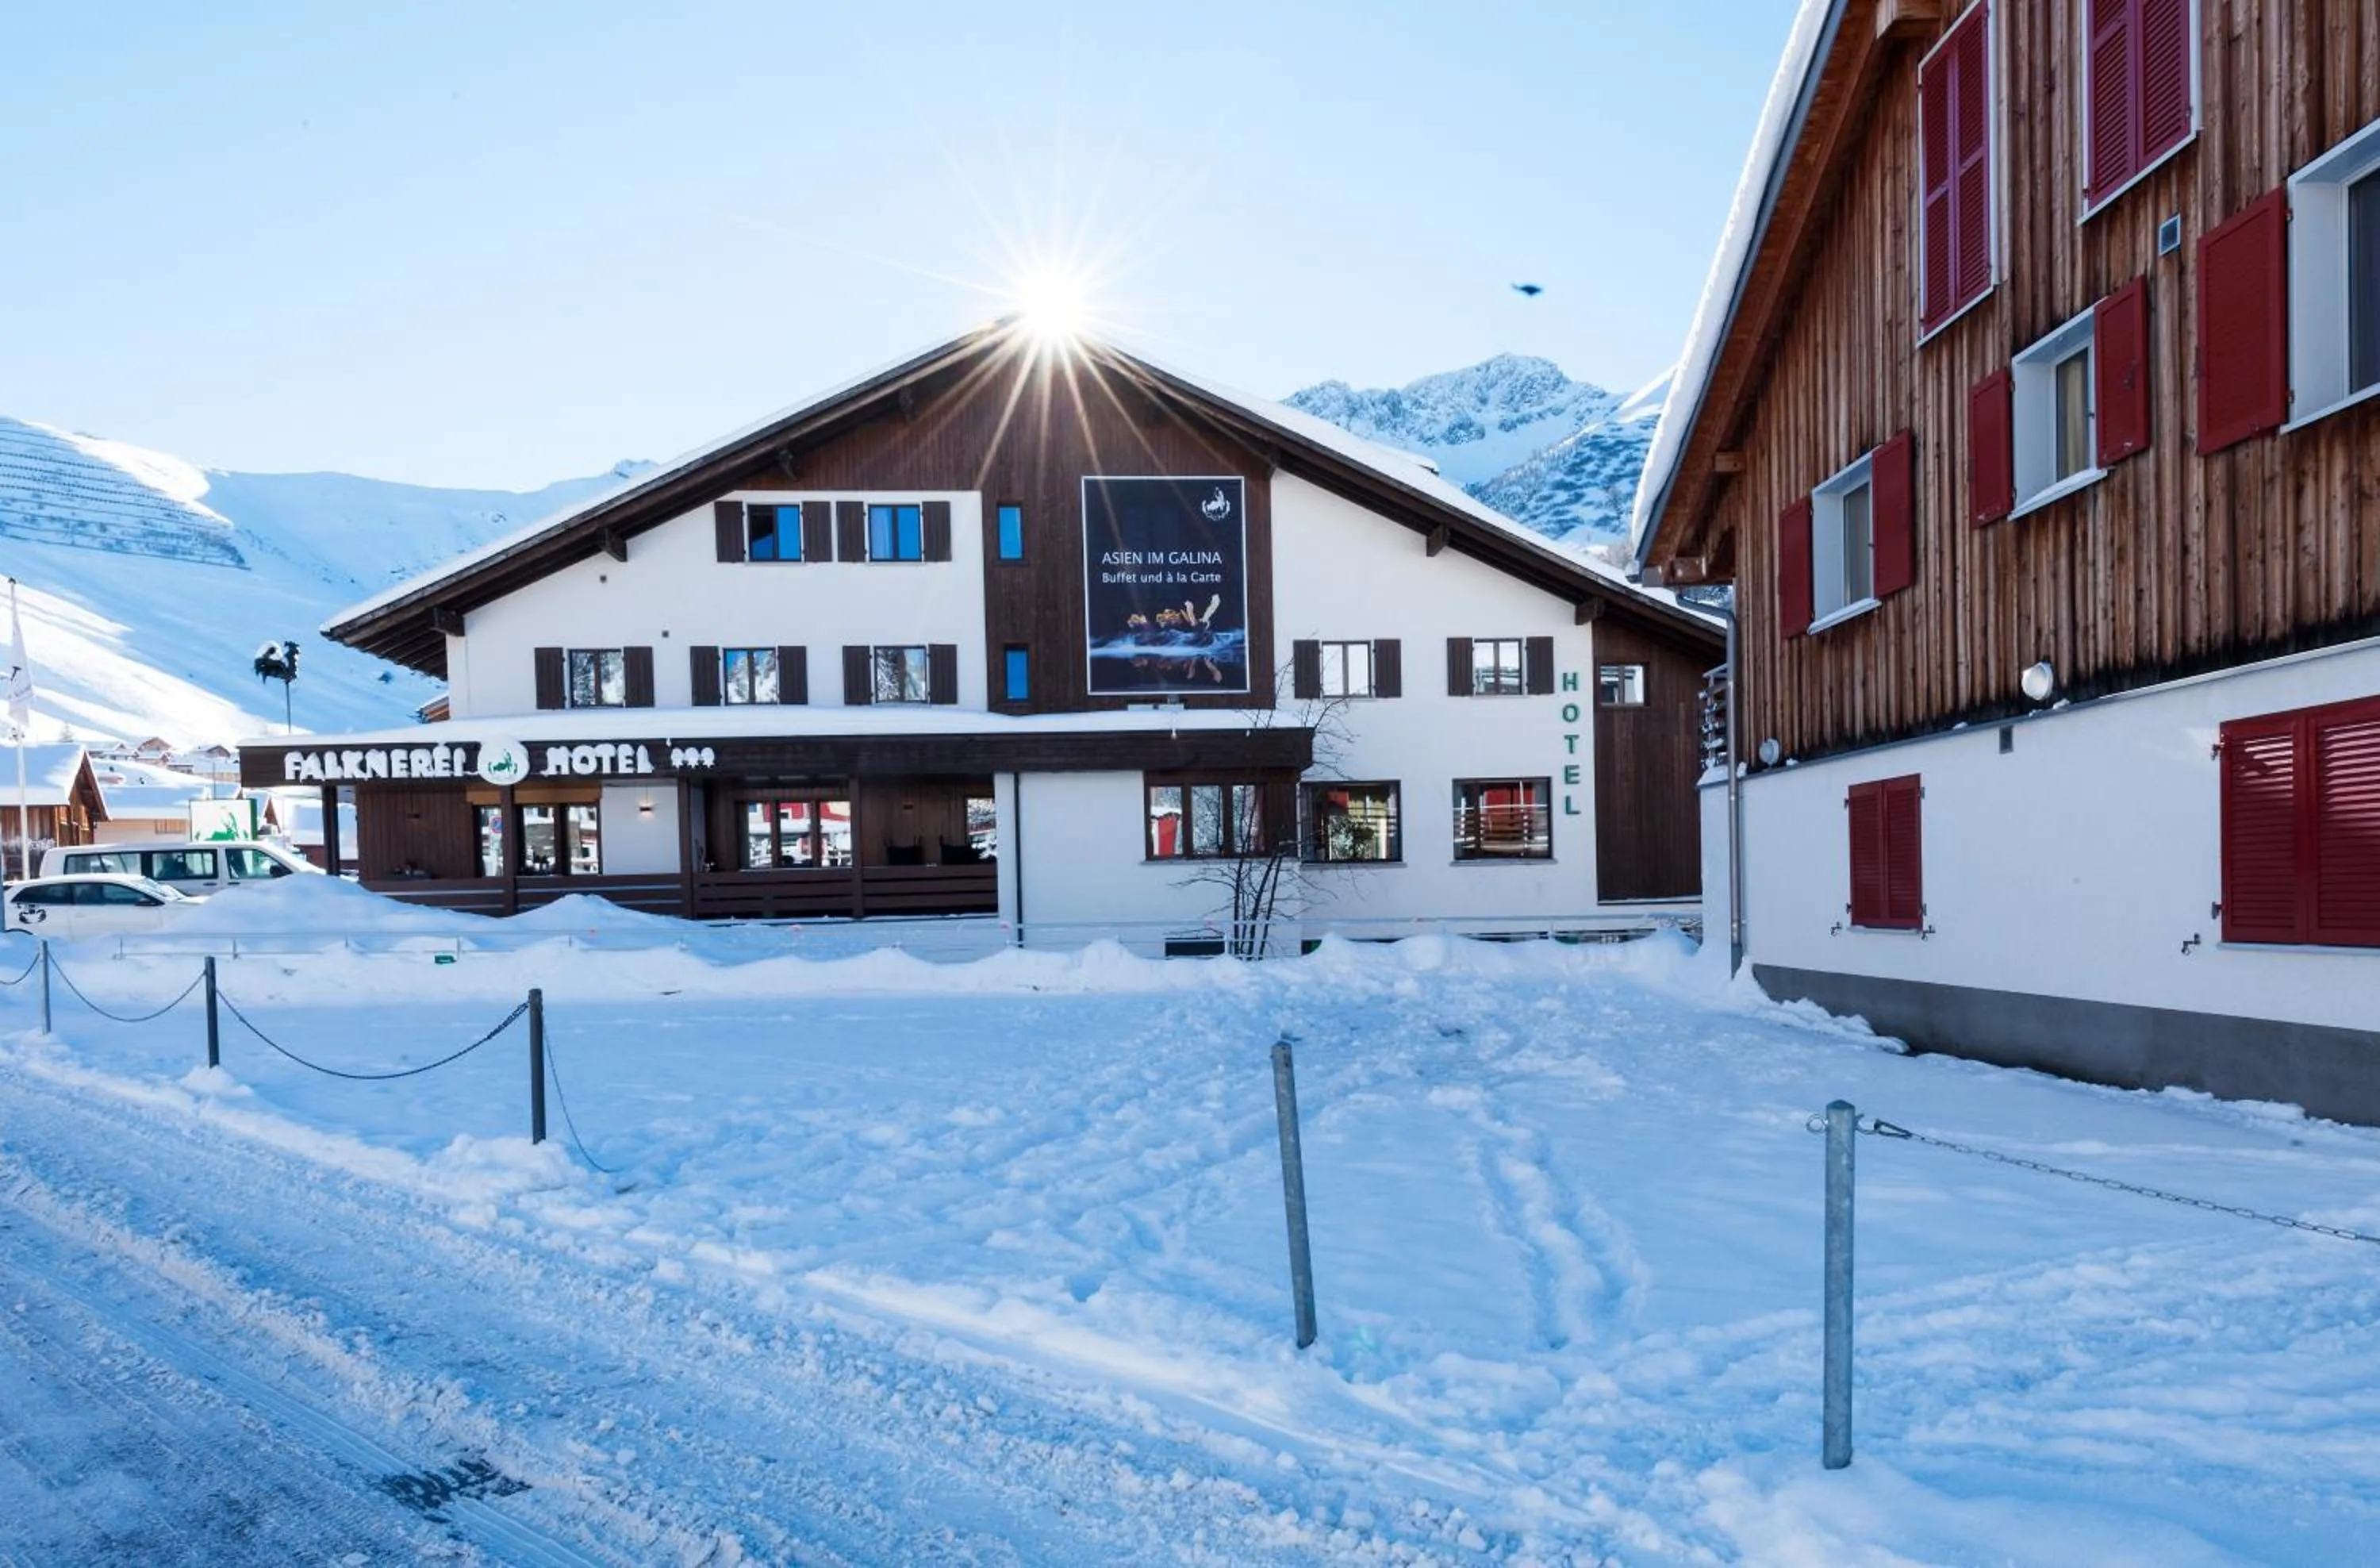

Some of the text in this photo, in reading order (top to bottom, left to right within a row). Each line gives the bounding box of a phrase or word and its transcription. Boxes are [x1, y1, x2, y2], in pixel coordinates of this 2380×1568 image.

[1101, 551, 1223, 564] ASIEN IM GALINA
[1102, 571, 1222, 583] Buffet und à la Carte
[1561, 672, 1582, 815] HOTEL
[545, 744, 654, 775] HOTEL
